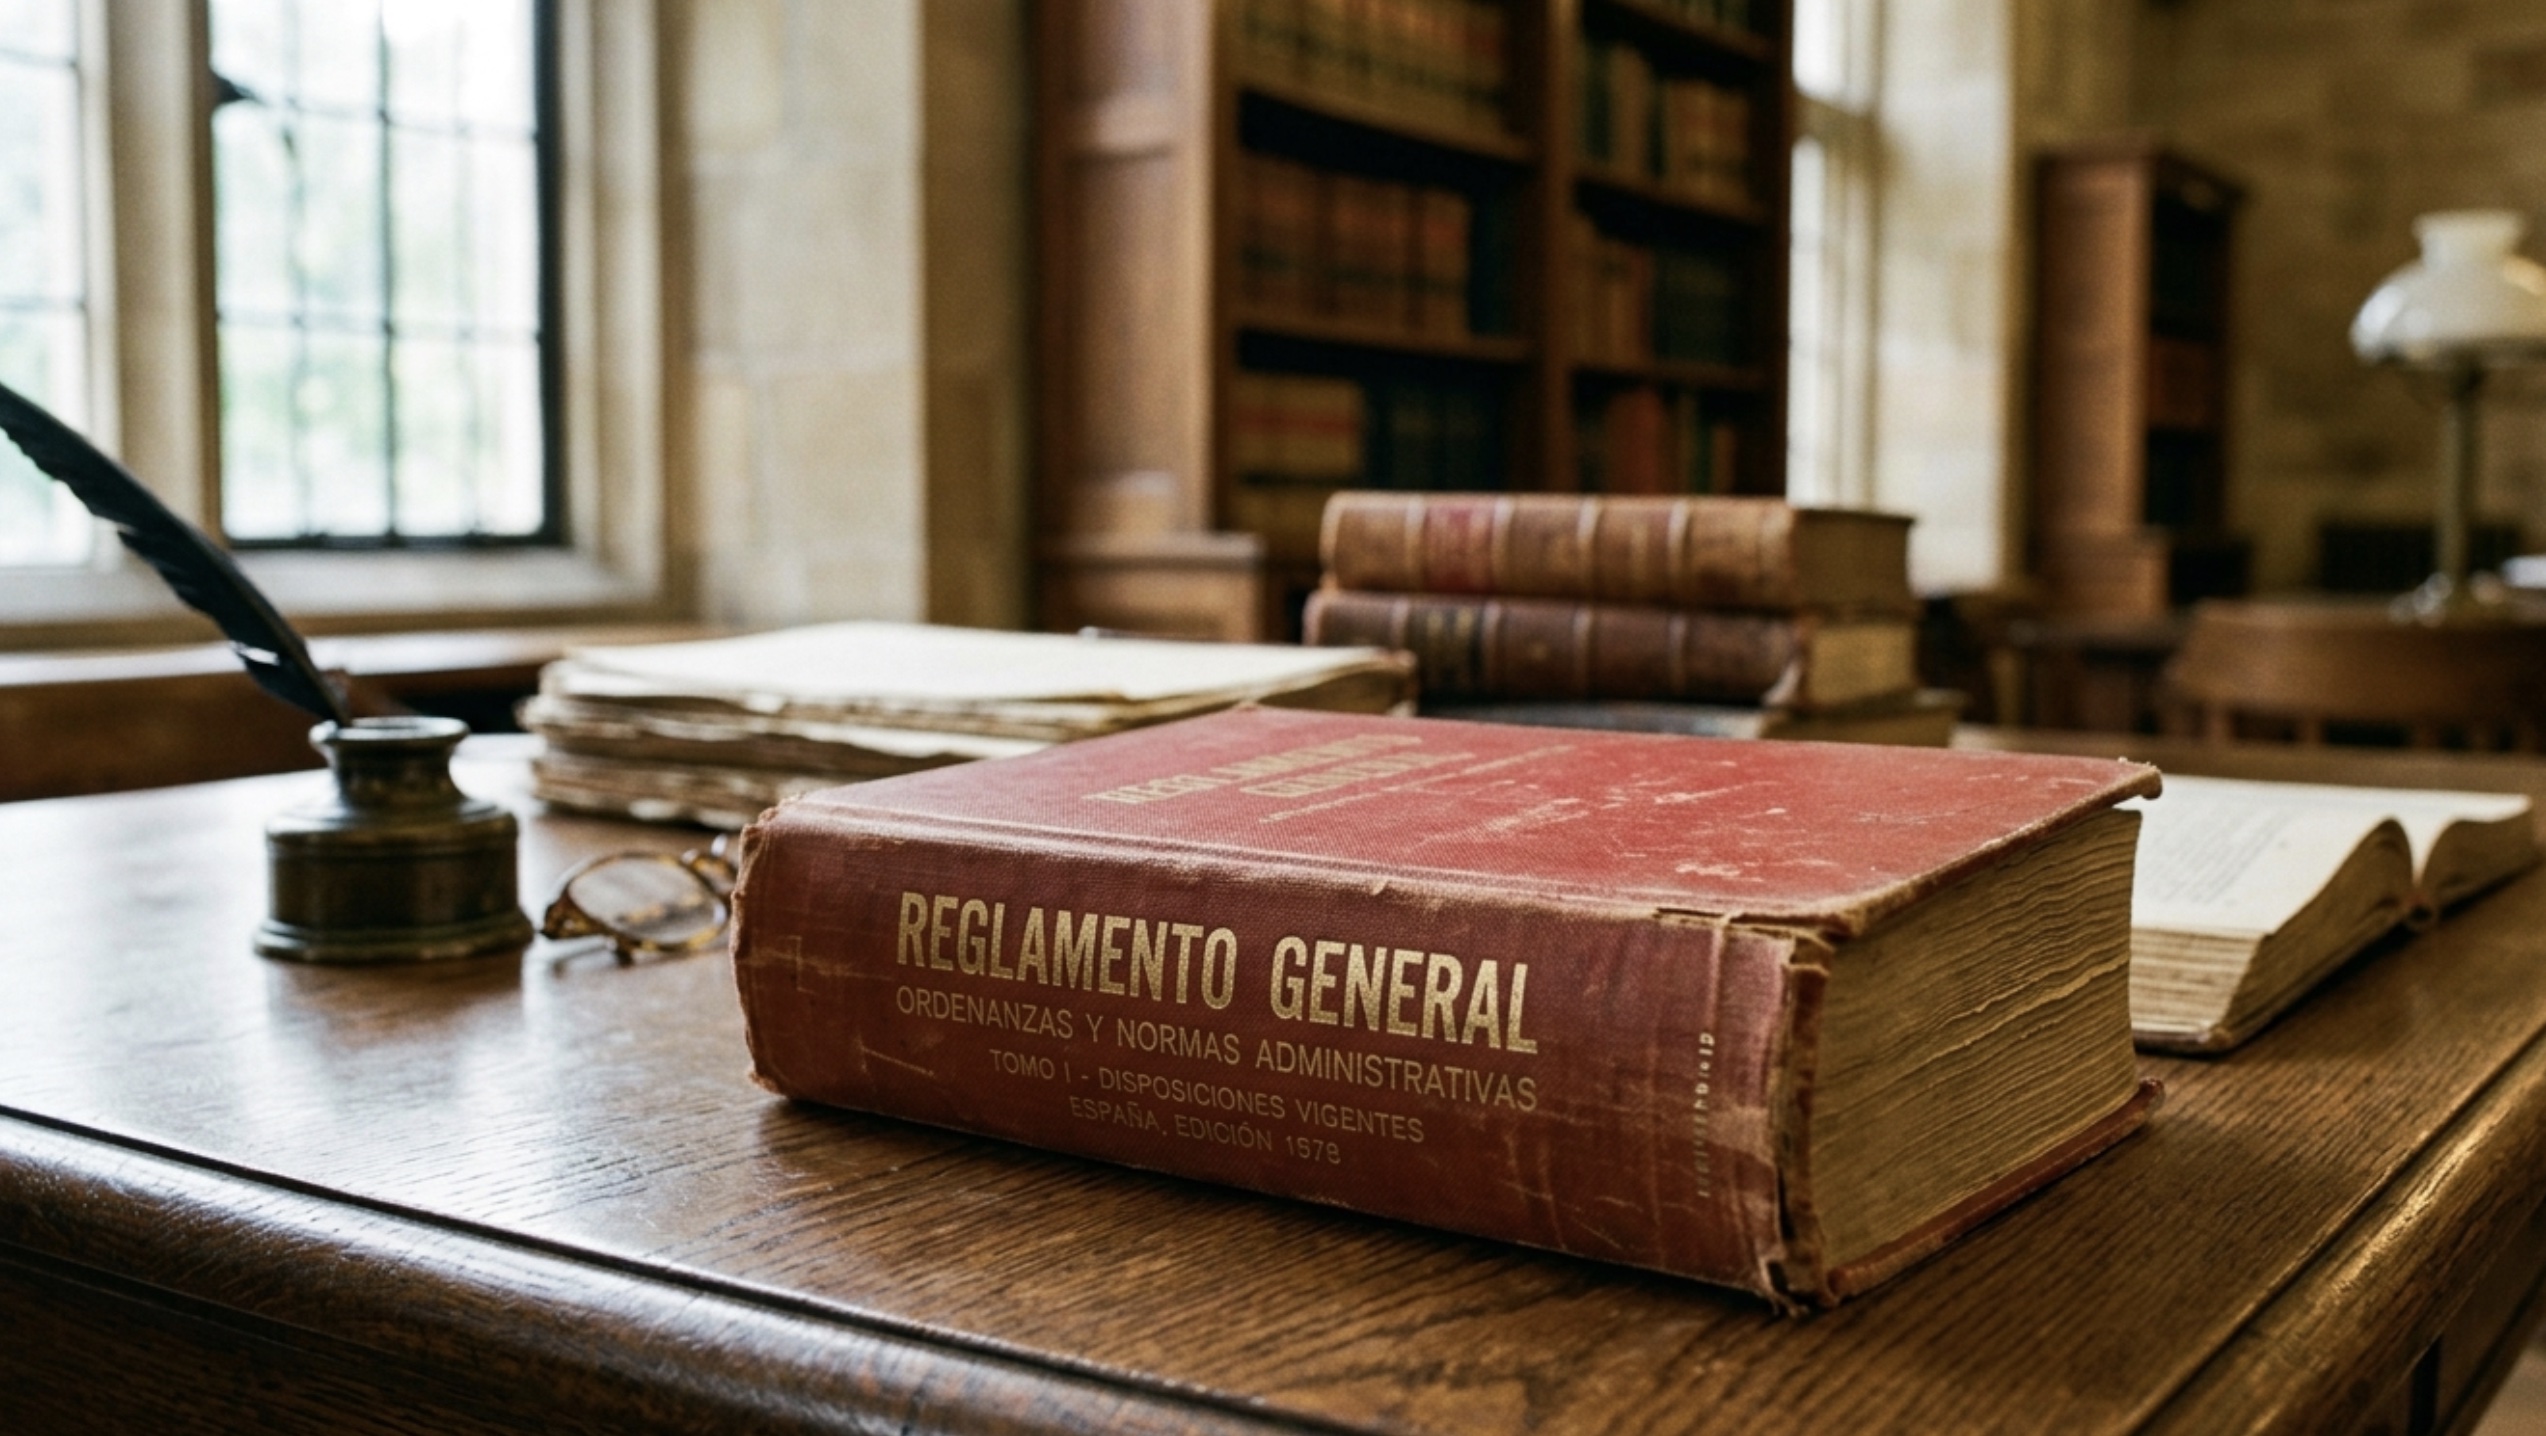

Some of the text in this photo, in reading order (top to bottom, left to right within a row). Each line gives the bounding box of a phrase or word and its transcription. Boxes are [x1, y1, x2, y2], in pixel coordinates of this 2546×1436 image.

[896, 890, 1539, 1054] REGLAMENTO GENERAL
[896, 985, 1538, 1113] ORDENANZAS Y NORMAS ADMINISTRATIVAS
[989, 1049, 1056, 1080] TOMO
[1063, 1060, 1072, 1083] I
[1099, 1067, 1286, 1119] DISPOSICIONES
[1296, 1099, 1425, 1143] VIGENTES
[1174, 1113, 1273, 1151] EDICIÓN
